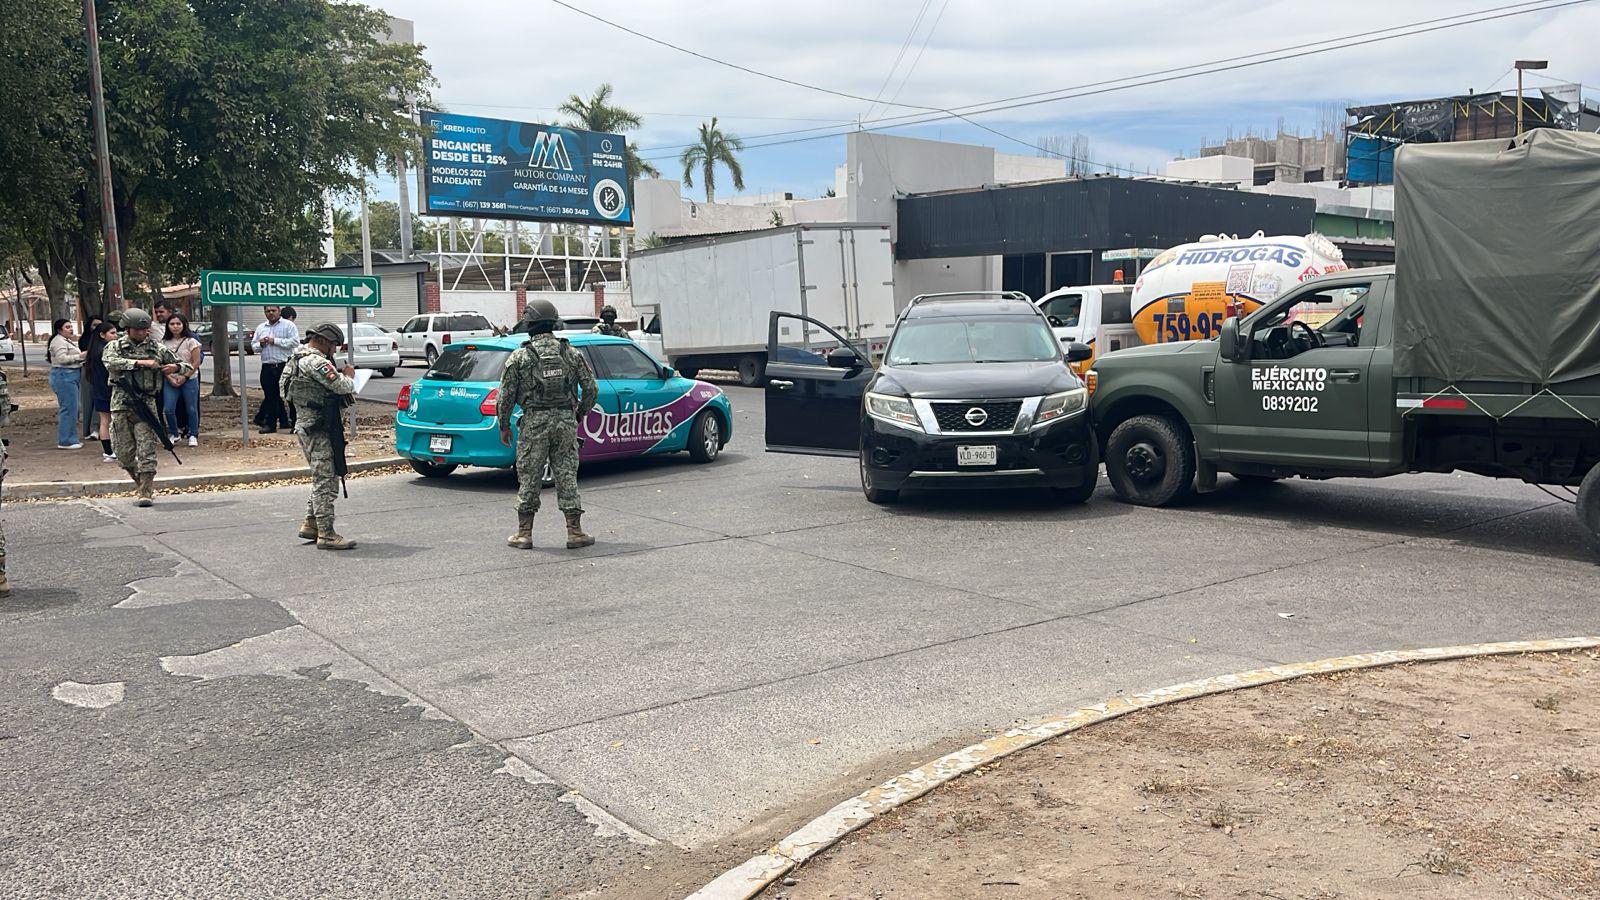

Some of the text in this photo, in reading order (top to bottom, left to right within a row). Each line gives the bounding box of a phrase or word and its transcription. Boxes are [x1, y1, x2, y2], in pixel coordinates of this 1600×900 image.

[443, 124, 465, 133] KREDI
[431, 139, 492, 153] ENGANCHE
[432, 151, 508, 166] DESDE EL 25%
[592, 159, 623, 169] EN 24HR
[431, 166, 487, 178] MODELOS 2021
[514, 169, 587, 183] MOTOR COMPANY
[432, 176, 482, 186] EN ADELANTE
[513, 182, 548, 192] GARANTÍA
[568, 187, 589, 196] MESES
[462, 201, 479, 209] (667)
[480, 201, 490, 209] 139
[546, 206, 561, 214] (667)
[1175, 247, 1304, 268] HIDROGAS
[211, 281, 350, 299] AURA RESIDENCIAL
[1251, 365, 1327, 381] EJÉRCITO
[1252, 380, 1326, 392] MEXICANO
[1262, 395, 1319, 412] 0839202
[583, 402, 673, 444] Quálitas
